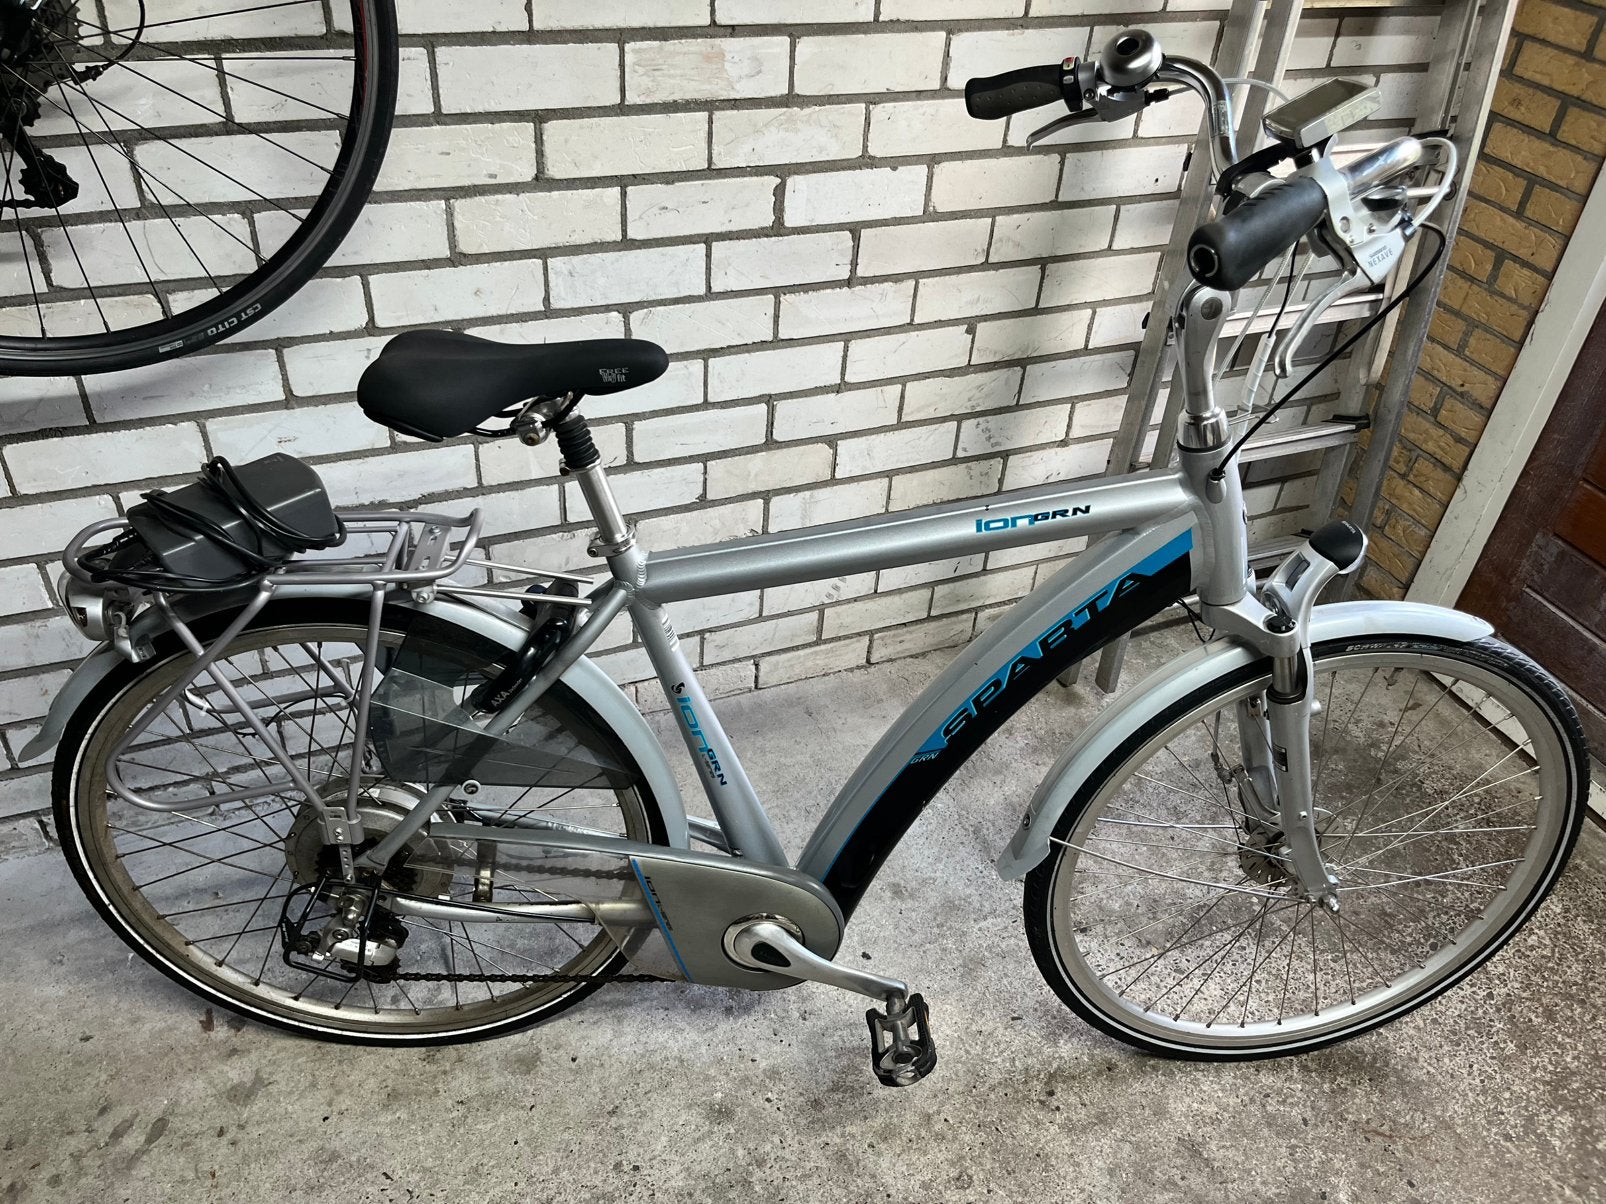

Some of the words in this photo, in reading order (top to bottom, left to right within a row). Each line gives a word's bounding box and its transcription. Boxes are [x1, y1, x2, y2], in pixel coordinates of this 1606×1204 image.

[1367, 248, 1393, 267] NEXAVE
[241, 303, 262, 321] CST
[207, 317, 239, 337] CITO
[940, 571, 1151, 745] SPARTA
[490, 691, 510, 707] AXA
[910, 751, 939, 764] GRN
